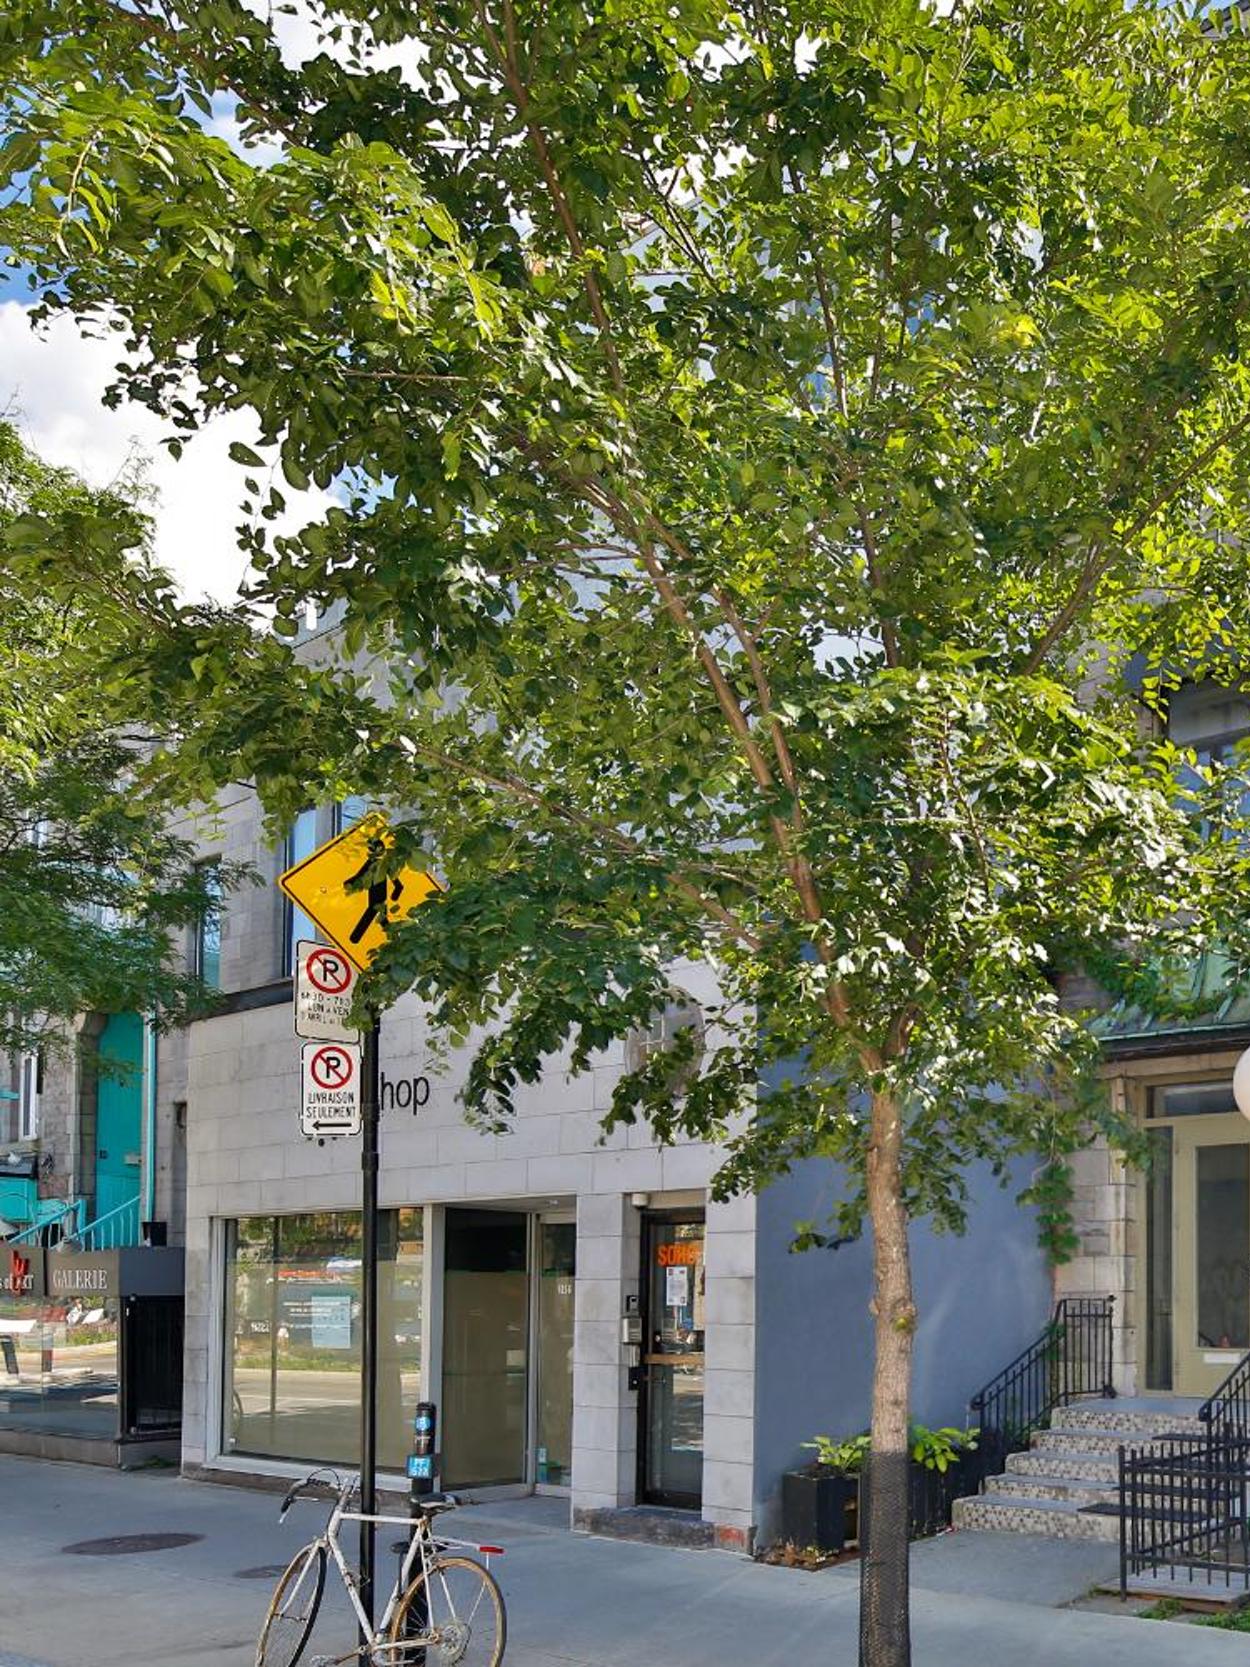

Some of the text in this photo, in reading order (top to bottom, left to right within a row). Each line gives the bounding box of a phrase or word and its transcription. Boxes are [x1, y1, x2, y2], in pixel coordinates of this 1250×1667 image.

[308, 1091, 354, 1104] LIVRAISON
[306, 1106, 356, 1119] SEULEMENT
[52, 1270, 108, 1289] GALERIE
